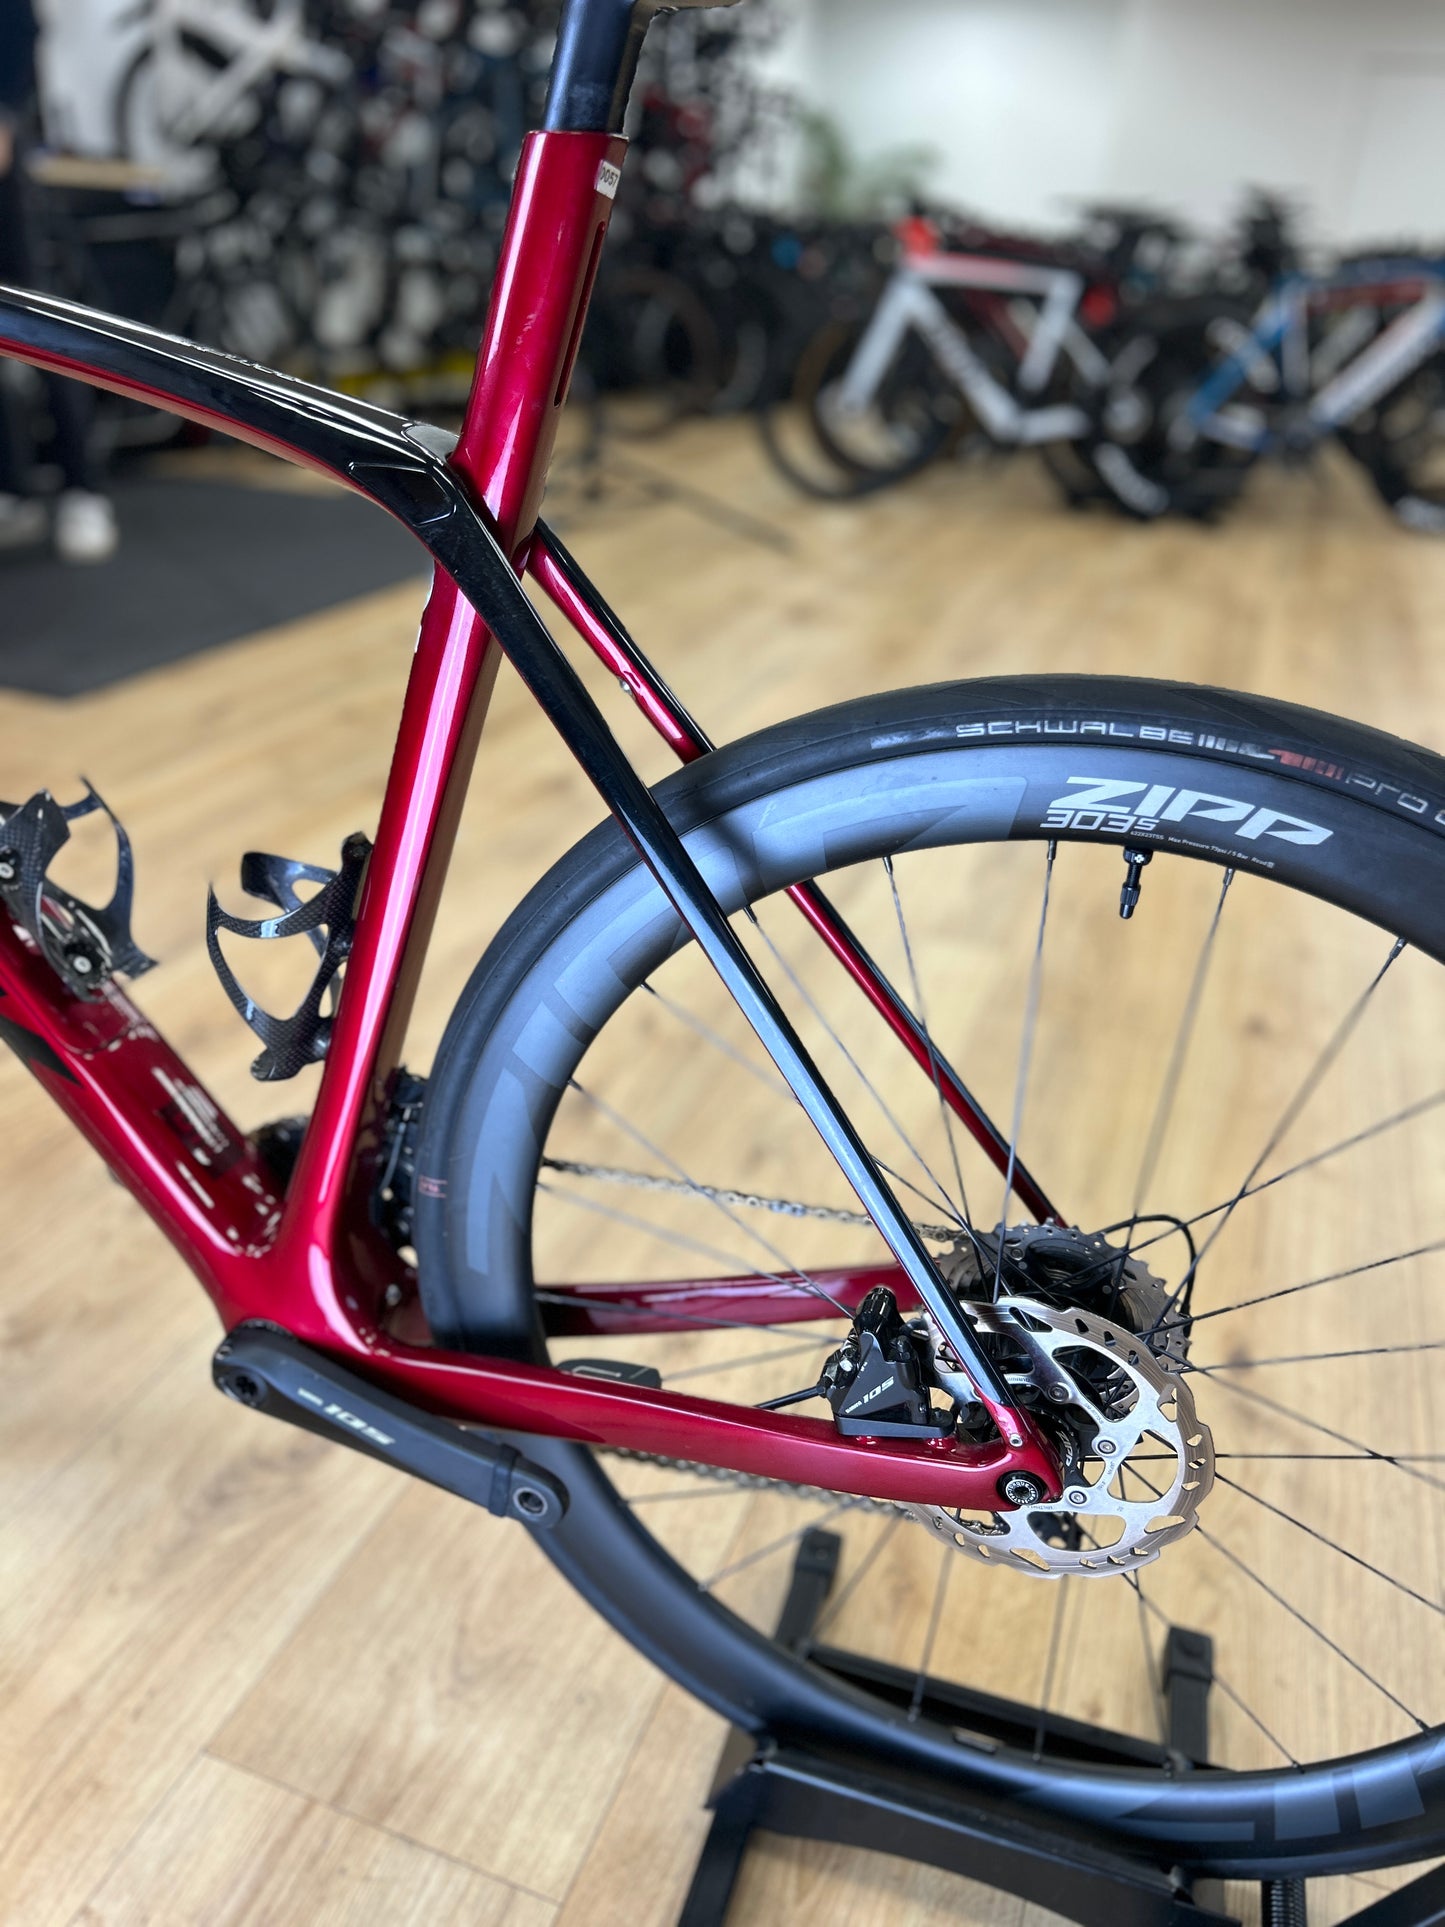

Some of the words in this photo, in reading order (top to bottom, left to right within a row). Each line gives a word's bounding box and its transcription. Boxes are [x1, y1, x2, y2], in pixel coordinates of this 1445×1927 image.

[956, 720, 1195, 746] SCHWALBE
[1047, 776, 1334, 846] ZIPP
[1182, 839, 1210, 850] Pressure
[863, 1376, 894, 1404] 105
[323, 1403, 396, 1445] 105
[1056, 1430, 1074, 1467] ZIPP
